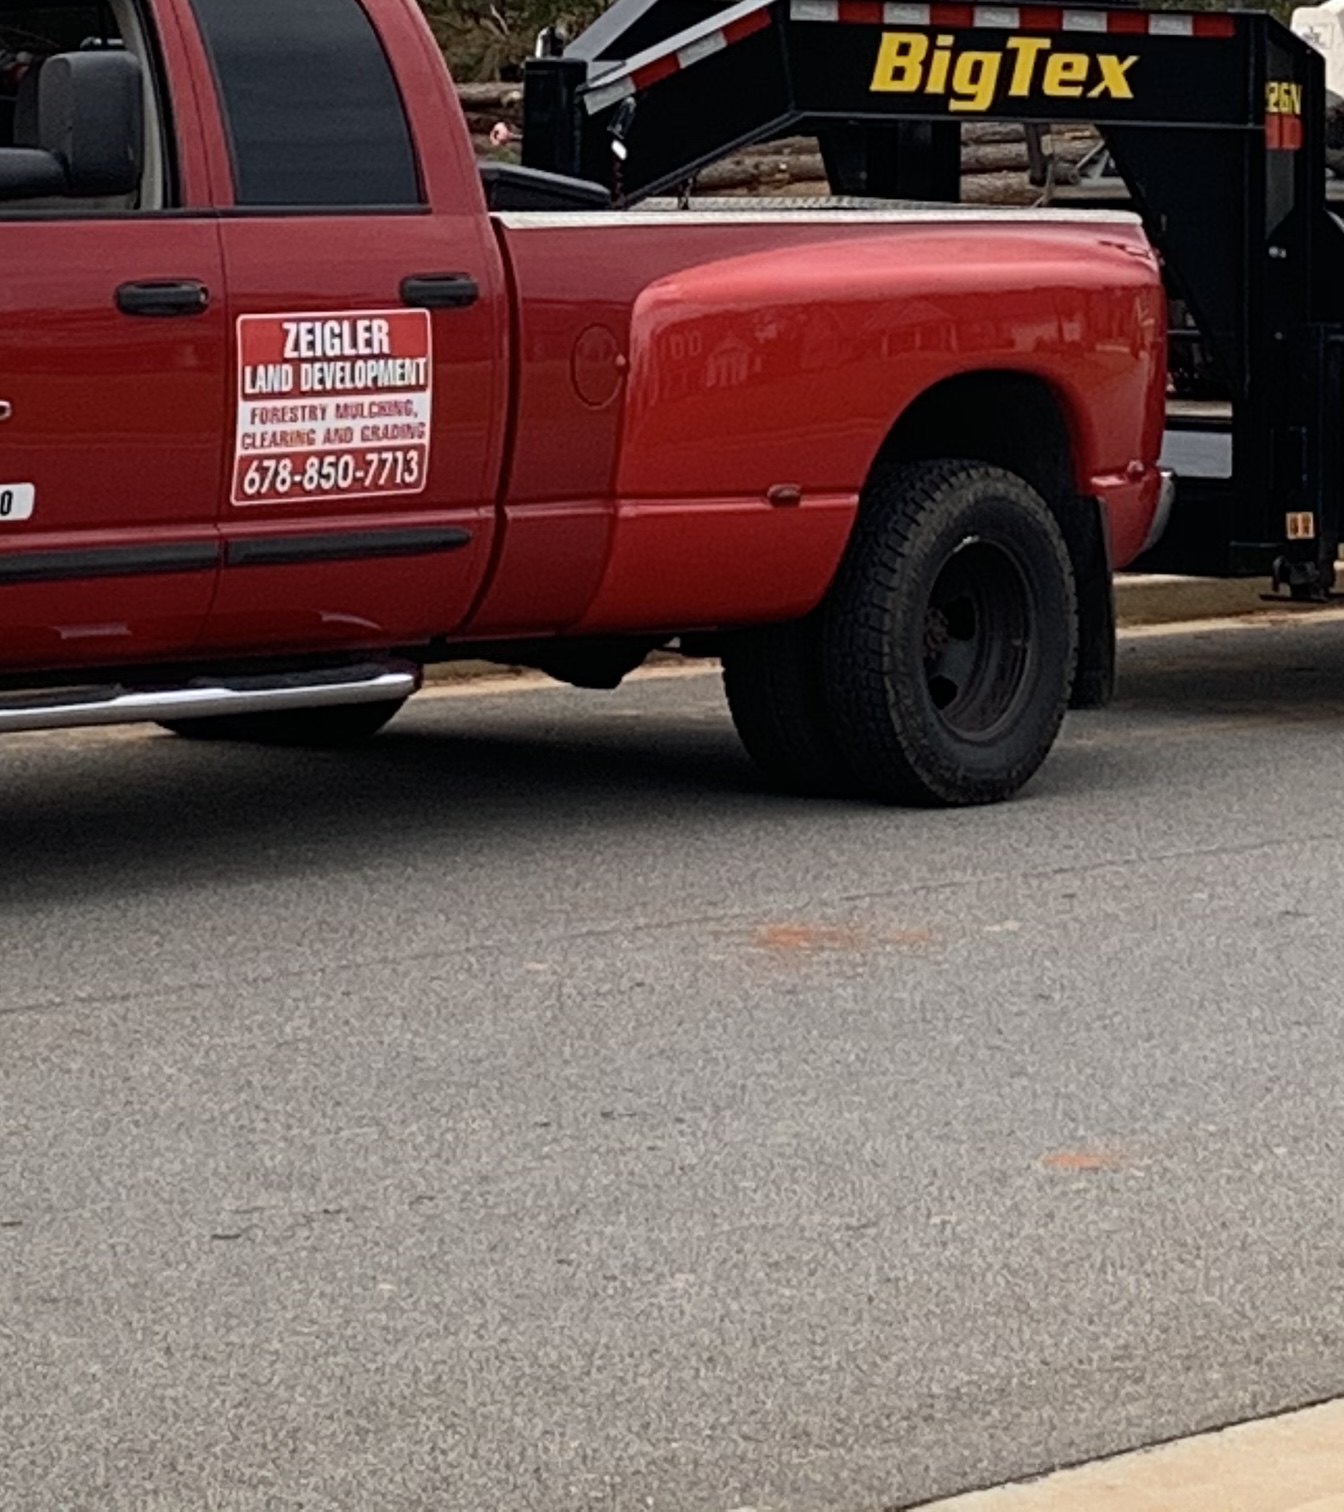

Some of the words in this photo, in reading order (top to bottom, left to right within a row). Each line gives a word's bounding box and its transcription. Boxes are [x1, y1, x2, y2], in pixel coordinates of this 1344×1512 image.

[869, 31, 1141, 112] BigTex
[281, 318, 391, 359] ZEIGLER
[243, 363, 294, 395] LAND
[299, 357, 428, 393] DEVELOPMENT
[250, 402, 328, 425] FORESTRY
[334, 399, 419, 421] MULCHING,
[241, 428, 317, 450] CLEARING
[322, 425, 354, 445] AND
[360, 421, 427, 443] GRADING
[243, 449, 419, 495] 678-850-7713
